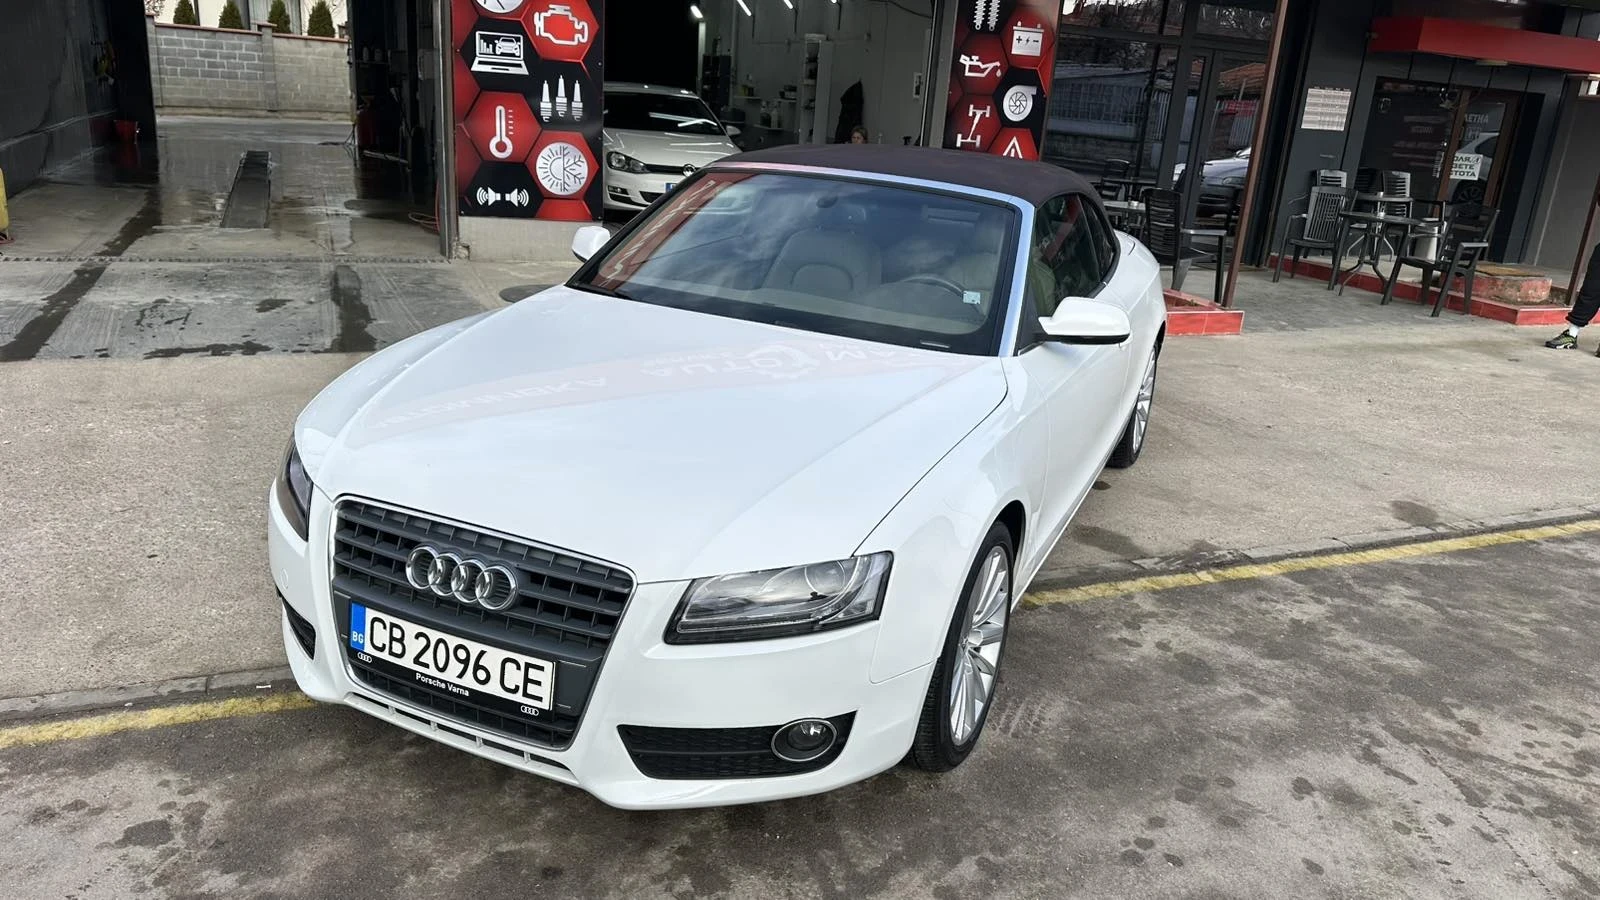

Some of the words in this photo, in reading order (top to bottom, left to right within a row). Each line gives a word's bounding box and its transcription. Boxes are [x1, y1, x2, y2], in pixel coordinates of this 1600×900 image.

[352, 631, 364, 644] BG
[370, 616, 407, 659] CB
[413, 631, 491, 686] 2096
[499, 656, 545, 703] CE
[415, 672, 446, 689] Porsche
[447, 682, 470, 697] Varna
